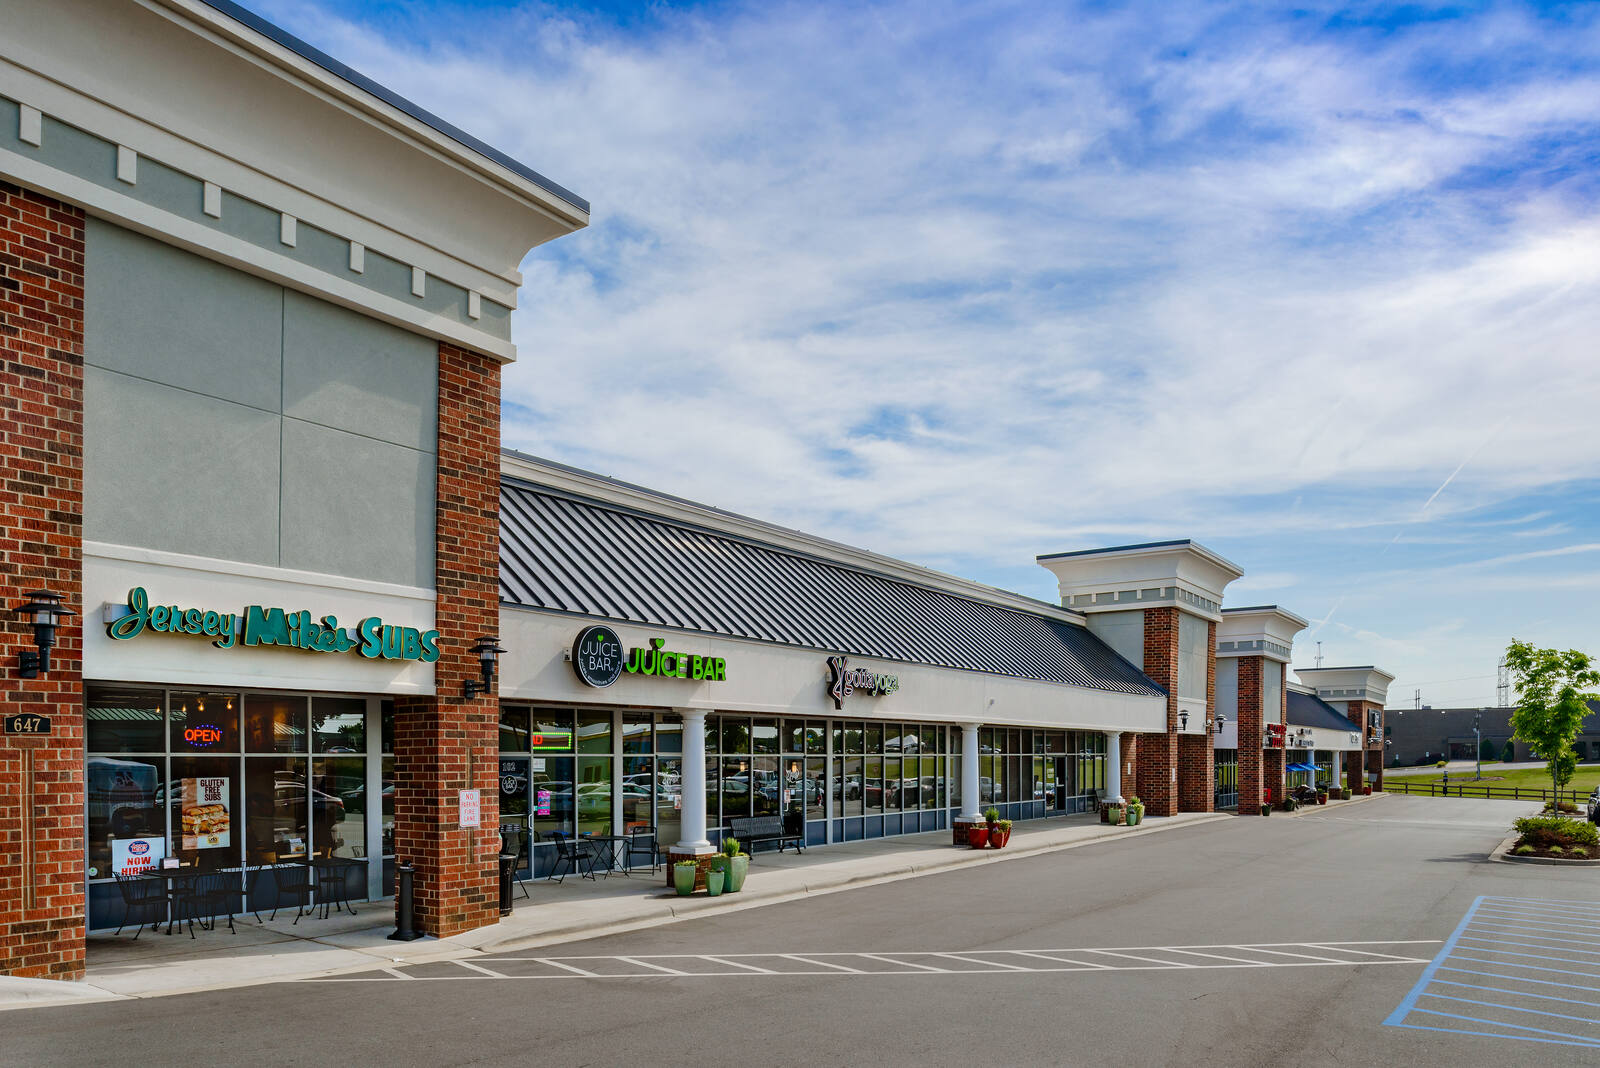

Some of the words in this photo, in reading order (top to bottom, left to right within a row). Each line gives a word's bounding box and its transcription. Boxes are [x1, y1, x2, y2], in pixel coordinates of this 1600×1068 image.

[106, 587, 236, 649] Jersey
[241, 605, 358, 653] Mike's
[356, 616, 441, 663] SUBS
[582, 640, 618, 658] JUICE
[589, 655, 612, 671] BAR
[626, 639, 688, 679] JUICE
[691, 655, 727, 681] BAR
[13, 717, 41, 732] 647
[184, 729, 220, 742] OPEN
[200, 779, 225, 787] GLUTEN
[204, 786, 221, 794] FREE
[204, 793, 222, 801] SUBS
[465, 793, 474, 801] NO
[127, 856, 151, 866] NOW
